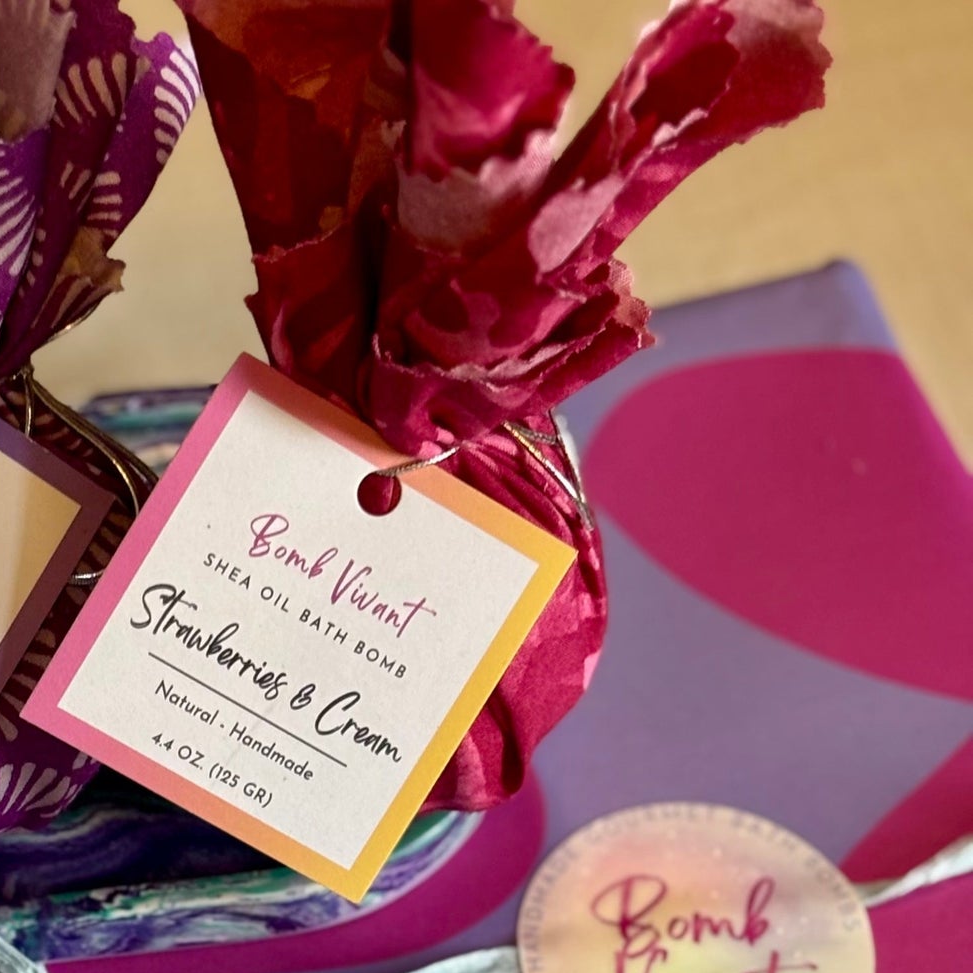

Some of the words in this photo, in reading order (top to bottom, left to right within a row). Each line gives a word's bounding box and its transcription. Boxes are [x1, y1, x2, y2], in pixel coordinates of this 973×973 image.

[203, 552, 251, 590] SHEA
[260, 585, 289, 613] OIL
[300, 608, 347, 643] BATH
[354, 639, 407, 679] BOMB
[249, 514, 338, 579] Bomb
[331, 559, 437, 639] Vivant
[129, 583, 287, 702] Strawberries
[291, 684, 315, 711] &
[314, 691, 402, 764] Cream
[155, 679, 218, 726] Natural
[229, 721, 314, 782] Handmade
[152, 734, 174, 754] 4.4
[177, 745, 203, 771] OZ.
[209, 762, 240, 789] (125
[242, 780, 274, 809] GR)
[590, 874, 776, 960] Bomb
